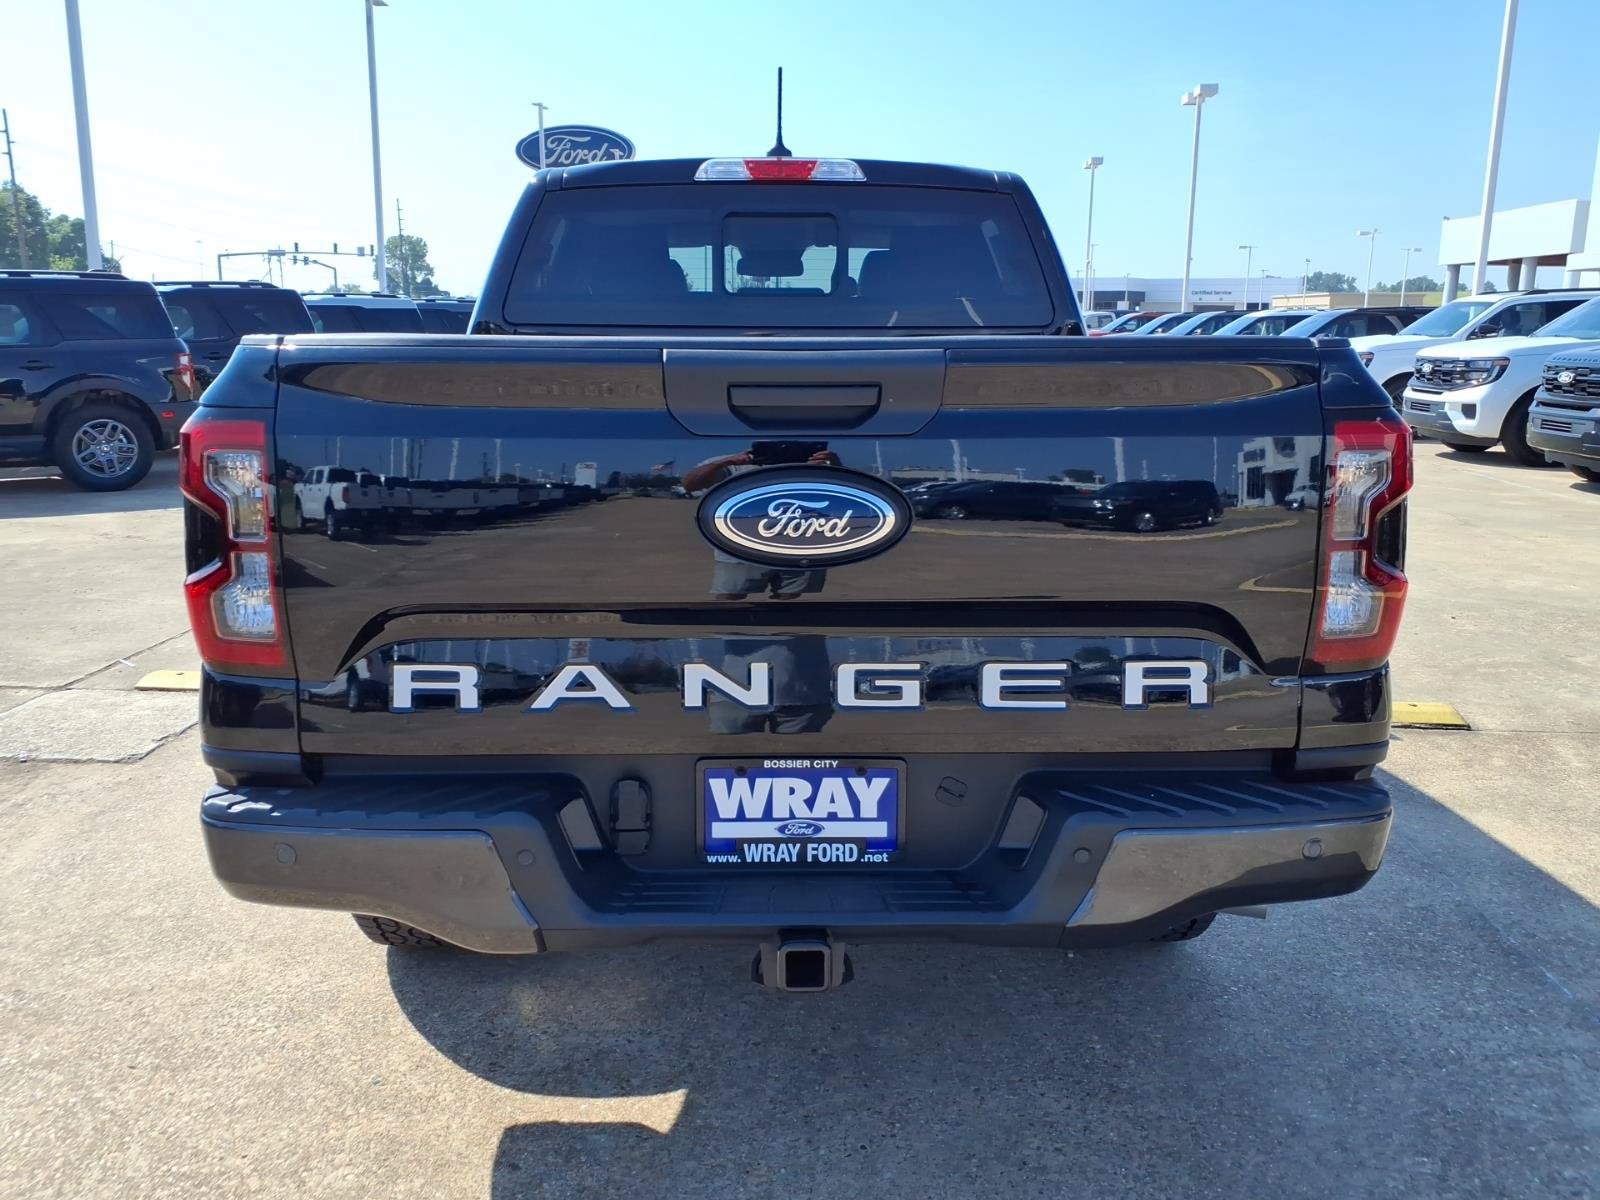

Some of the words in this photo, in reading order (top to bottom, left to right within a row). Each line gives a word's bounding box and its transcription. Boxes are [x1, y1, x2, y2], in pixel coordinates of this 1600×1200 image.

[542, 135, 609, 164] Ford
[757, 498, 853, 538] Ford
[390, 661, 1211, 711] RANGER
[763, 759, 811, 769] BOSSIER
[813, 759, 839, 769] CITY
[708, 777, 891, 819] WRAY
[784, 823, 815, 836] Ford
[706, 855, 741, 863] www.
[743, 843, 800, 863] WRAY
[806, 843, 858, 863] FORD
[860, 853, 889, 863] .net
